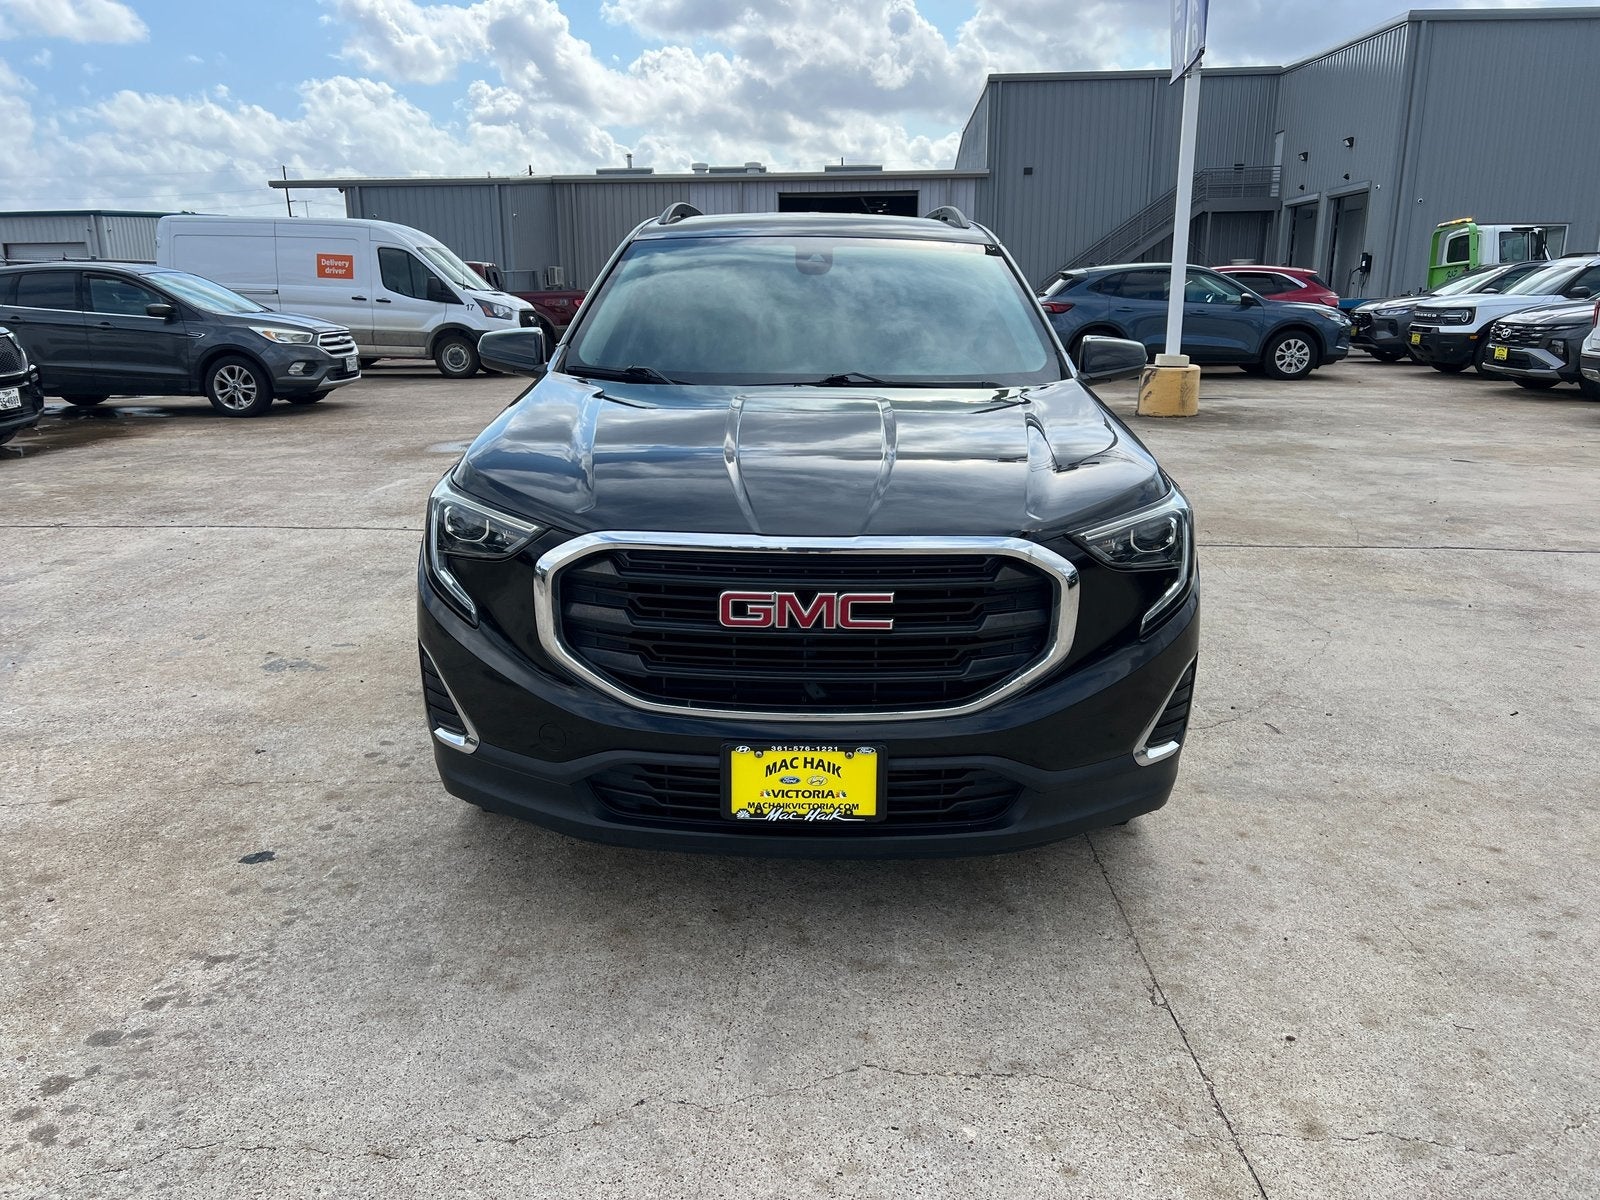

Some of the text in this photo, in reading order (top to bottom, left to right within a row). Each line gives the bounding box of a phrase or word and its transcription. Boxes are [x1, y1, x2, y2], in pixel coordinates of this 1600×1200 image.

[321, 258, 350, 268] Delivery
[325, 267, 346, 275] driver
[466, 303, 475, 311] 17
[719, 590, 895, 630] GMC
[765, 756, 842, 779] MAC HAIK
[771, 789, 836, 799] VICTORIA
[747, 801, 860, 811] MACHAIKVICTORIA.COM
[765, 807, 843, 822] Mac Haik
